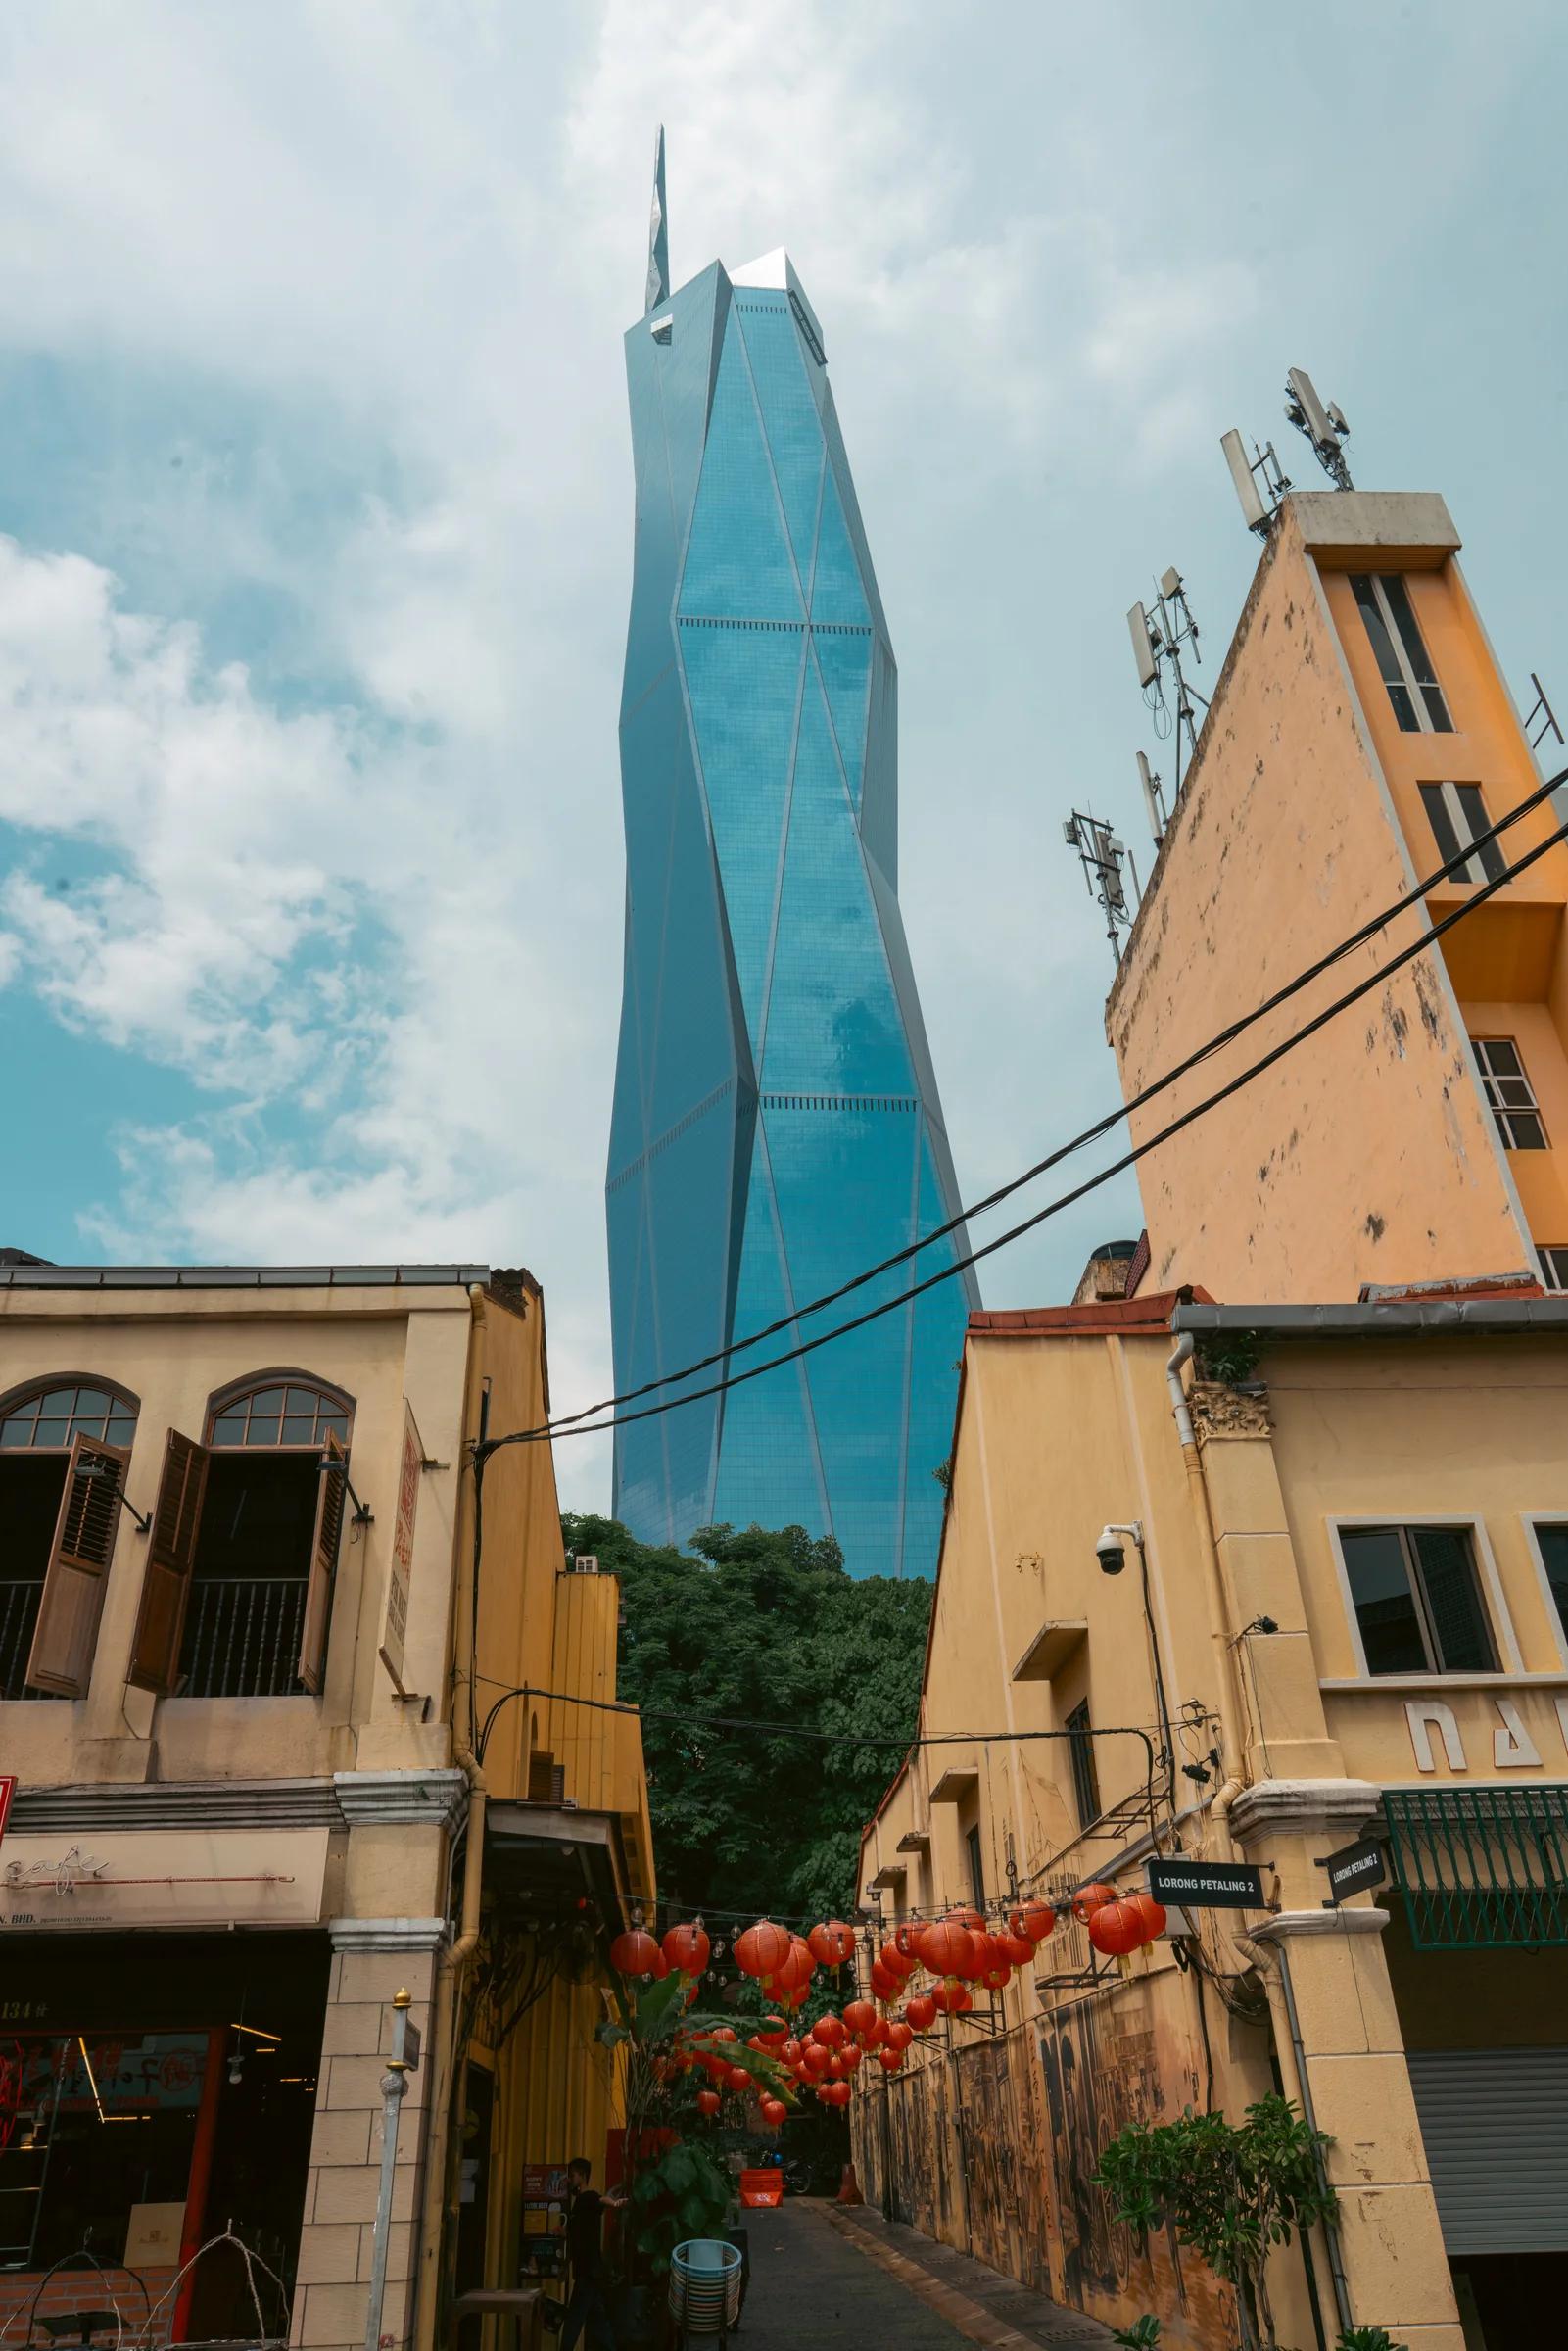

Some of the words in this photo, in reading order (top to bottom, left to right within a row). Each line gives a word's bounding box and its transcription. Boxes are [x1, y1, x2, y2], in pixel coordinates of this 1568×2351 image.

[1333, 1865, 1352, 1883] LORONG
[1351, 1857, 1373, 1877] PETALING
[1372, 1853, 1378, 1865] 2
[1158, 1877, 1199, 1890] LORONG
[1200, 1879, 1246, 1892] PETALING
[1247, 1881, 1255, 1893] 2
[11, 1914, 36, 1924] BHD.
[1, 2000, 31, 2019] 134
